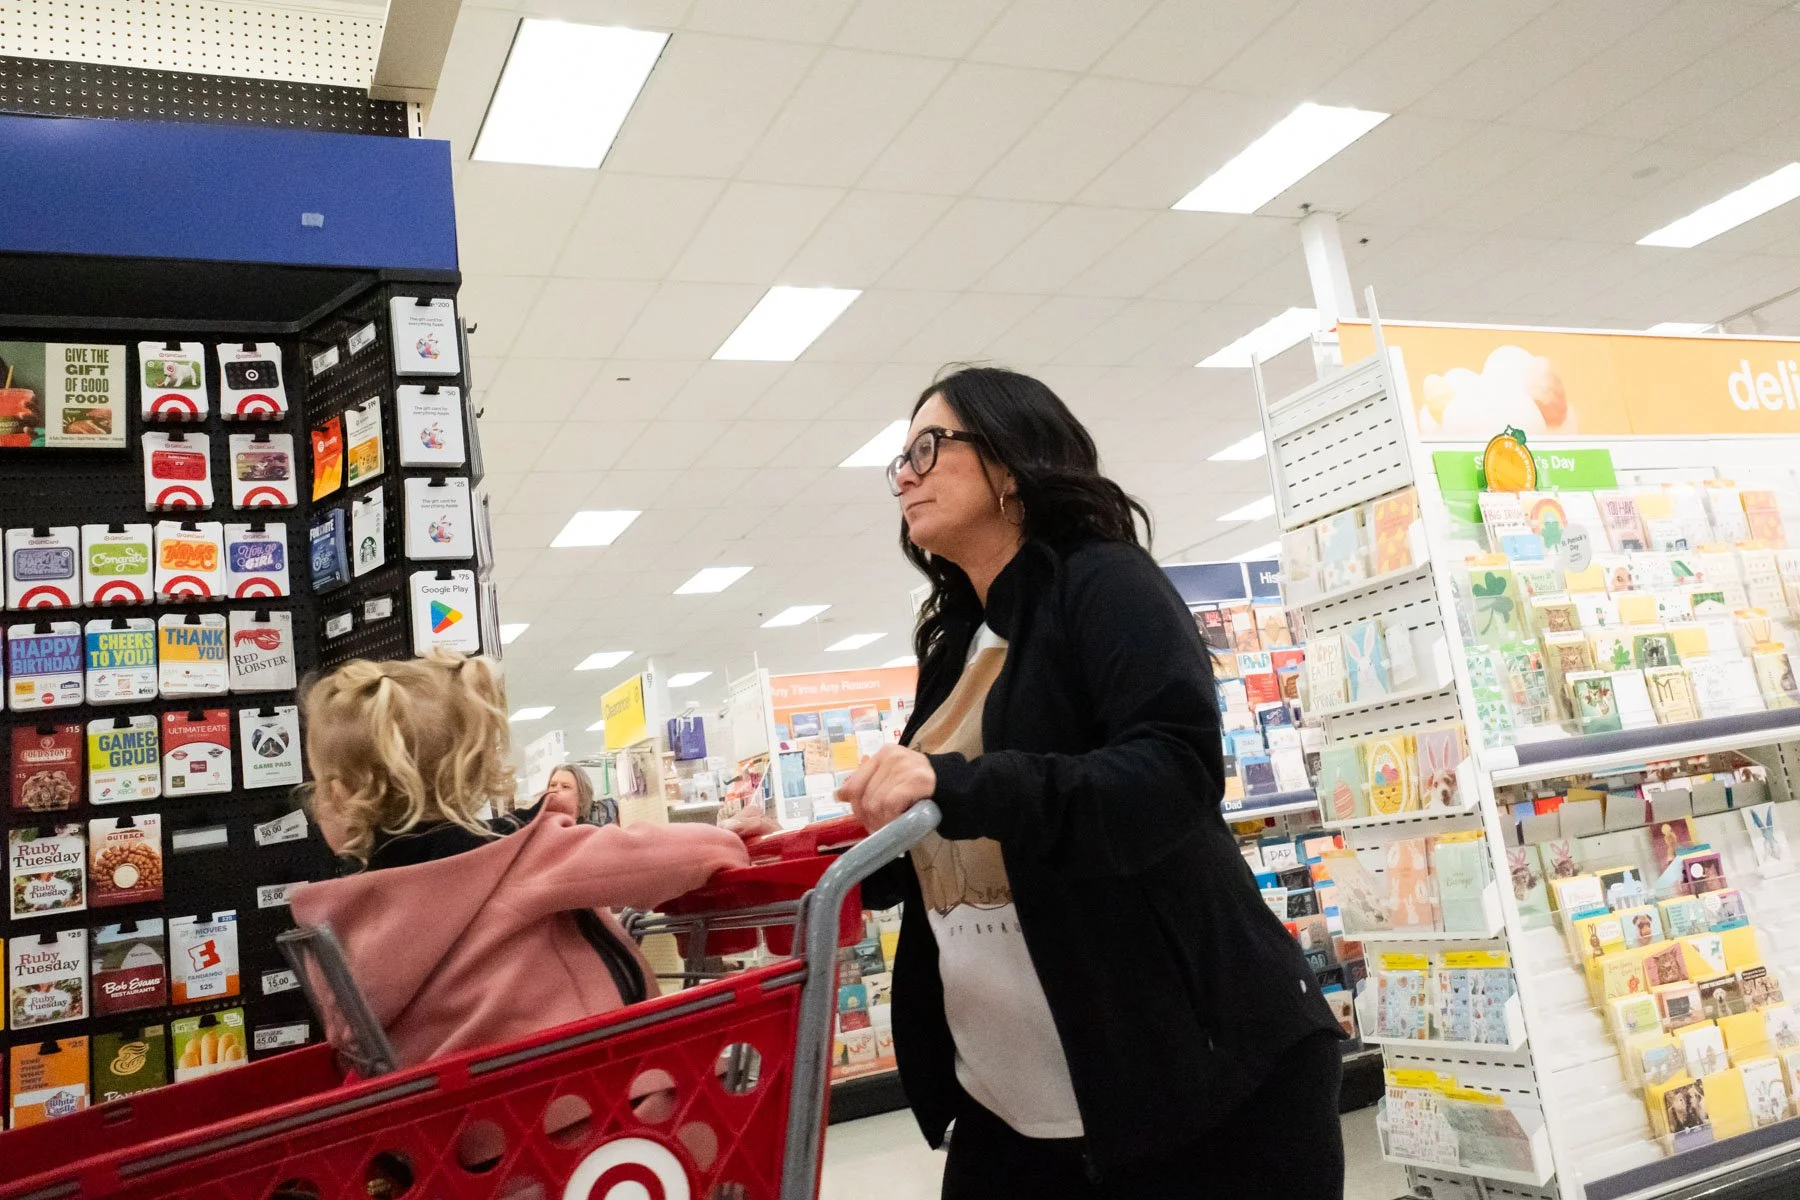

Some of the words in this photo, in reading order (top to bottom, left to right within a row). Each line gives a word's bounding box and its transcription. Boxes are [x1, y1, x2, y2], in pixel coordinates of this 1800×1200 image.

[65, 348, 88, 363] GIVE
[91, 349, 109, 363] THE
[65, 364, 109, 375] GIFT
[65, 378, 79, 392] OF
[81, 378, 109, 393] GOOD
[65, 394, 109, 404] FOOD
[1551, 456, 1575, 471] Day
[1569, 543, 1579, 552] Day
[92, 548, 148, 572] Congrats
[238, 555, 274, 569] GIRL
[421, 585, 451, 594] Google
[452, 585, 469, 593] Play
[99, 633, 154, 650] CHEERS
[165, 629, 225, 646] THANK
[11, 637, 80, 659] HAPPY
[198, 647, 225, 660] YOU
[90, 651, 109, 668] TO
[114, 649, 154, 666] YOU!
[233, 653, 259, 665] RED
[12, 655, 80, 675] BIRTHDAY
[237, 655, 288, 676] LOBSTER
[770, 687, 789, 698] Any
[790, 685, 817, 696] Time
[820, 681, 839, 694] Any
[841, 680, 881, 691] Reason
[168, 726, 205, 734] ULTIMATE
[207, 724, 227, 732] EATS
[23, 750, 45, 759] COLD
[45, 748, 71, 757] STONE
[109, 747, 158, 767] GRUB
[1225, 800, 1243, 811] Dad
[107, 832, 145, 841] OUTBACK
[261, 825, 282, 838] 50.00
[18, 843, 60, 856] Ruby
[1270, 849, 1292, 861] DAD
[13, 851, 81, 868] Tuesday
[29, 888, 68, 899] Tuesday
[32, 883, 57, 892] Ruby
[262, 892, 283, 901] 25.00
[195, 925, 227, 936] MOVIES
[20, 951, 60, 965] Ruby
[15, 959, 80, 976] Tuesday
[188, 971, 223, 981] FANDANGO
[102, 982, 127, 995] Bob
[129, 978, 161, 989] Evans
[200, 983, 213, 991] $25
[268, 977, 289, 988] 15.00
[111, 987, 156, 998] RESTAURANTS
[28, 999, 68, 1011] Tuesday
[31, 994, 56, 1004] Ruby
[256, 1035, 278, 1045] 45.00
[51, 1098, 74, 1107] White
[48, 1105, 76, 1115] Castle
